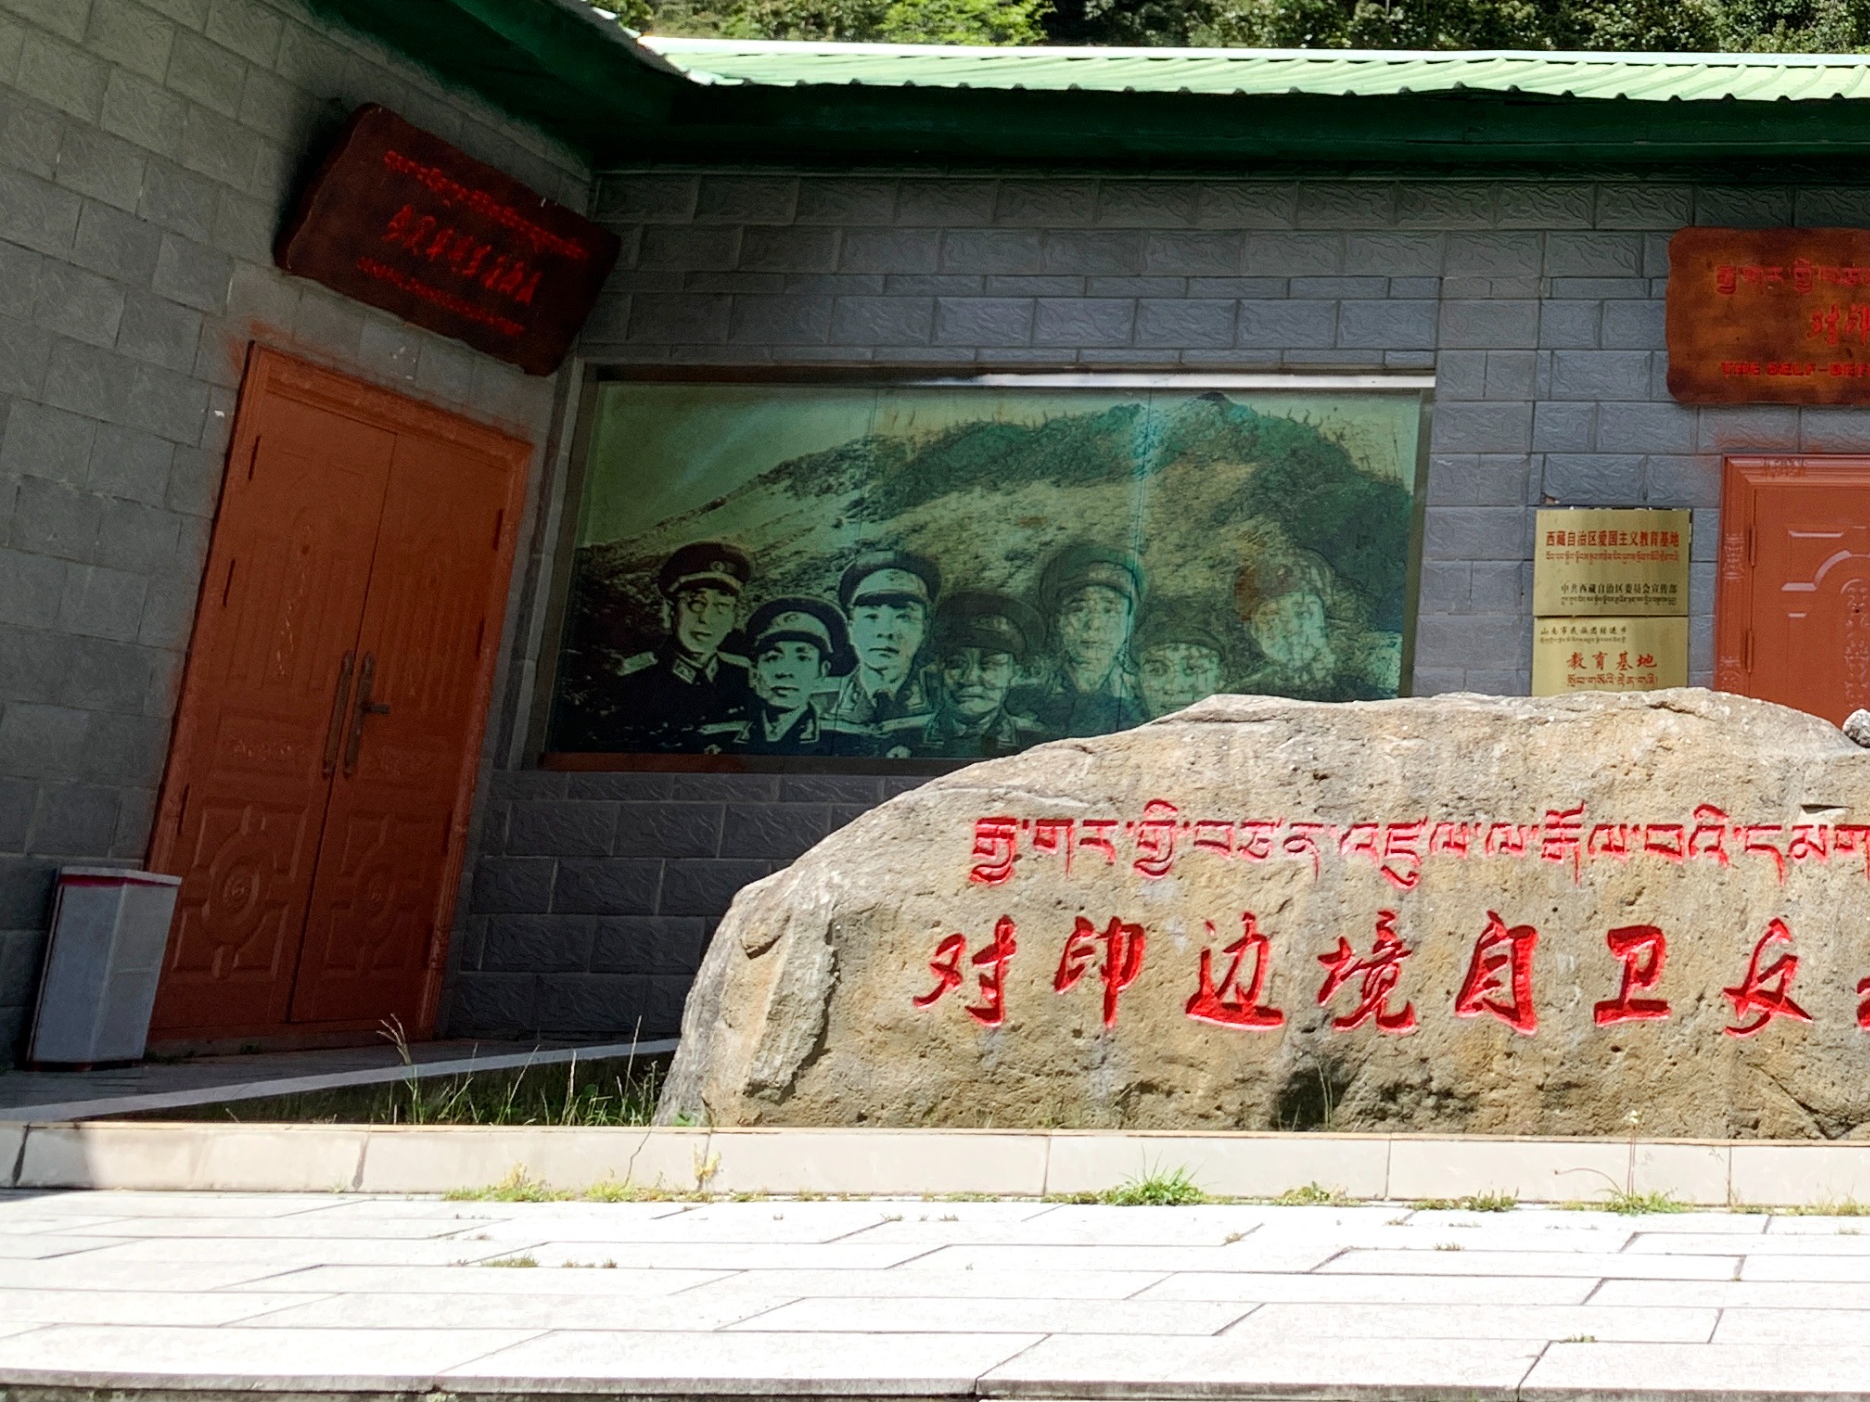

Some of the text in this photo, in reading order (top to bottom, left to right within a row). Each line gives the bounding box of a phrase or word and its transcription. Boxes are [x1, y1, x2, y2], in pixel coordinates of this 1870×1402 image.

[1721, 362, 1761, 376] THE
[1546, 531, 1680, 547] 西藏自治区爱国主义教育基地
[1561, 583, 1678, 595] 中共西藏自治区委员会宣传部
[1567, 651, 1657, 671] 教育基地
